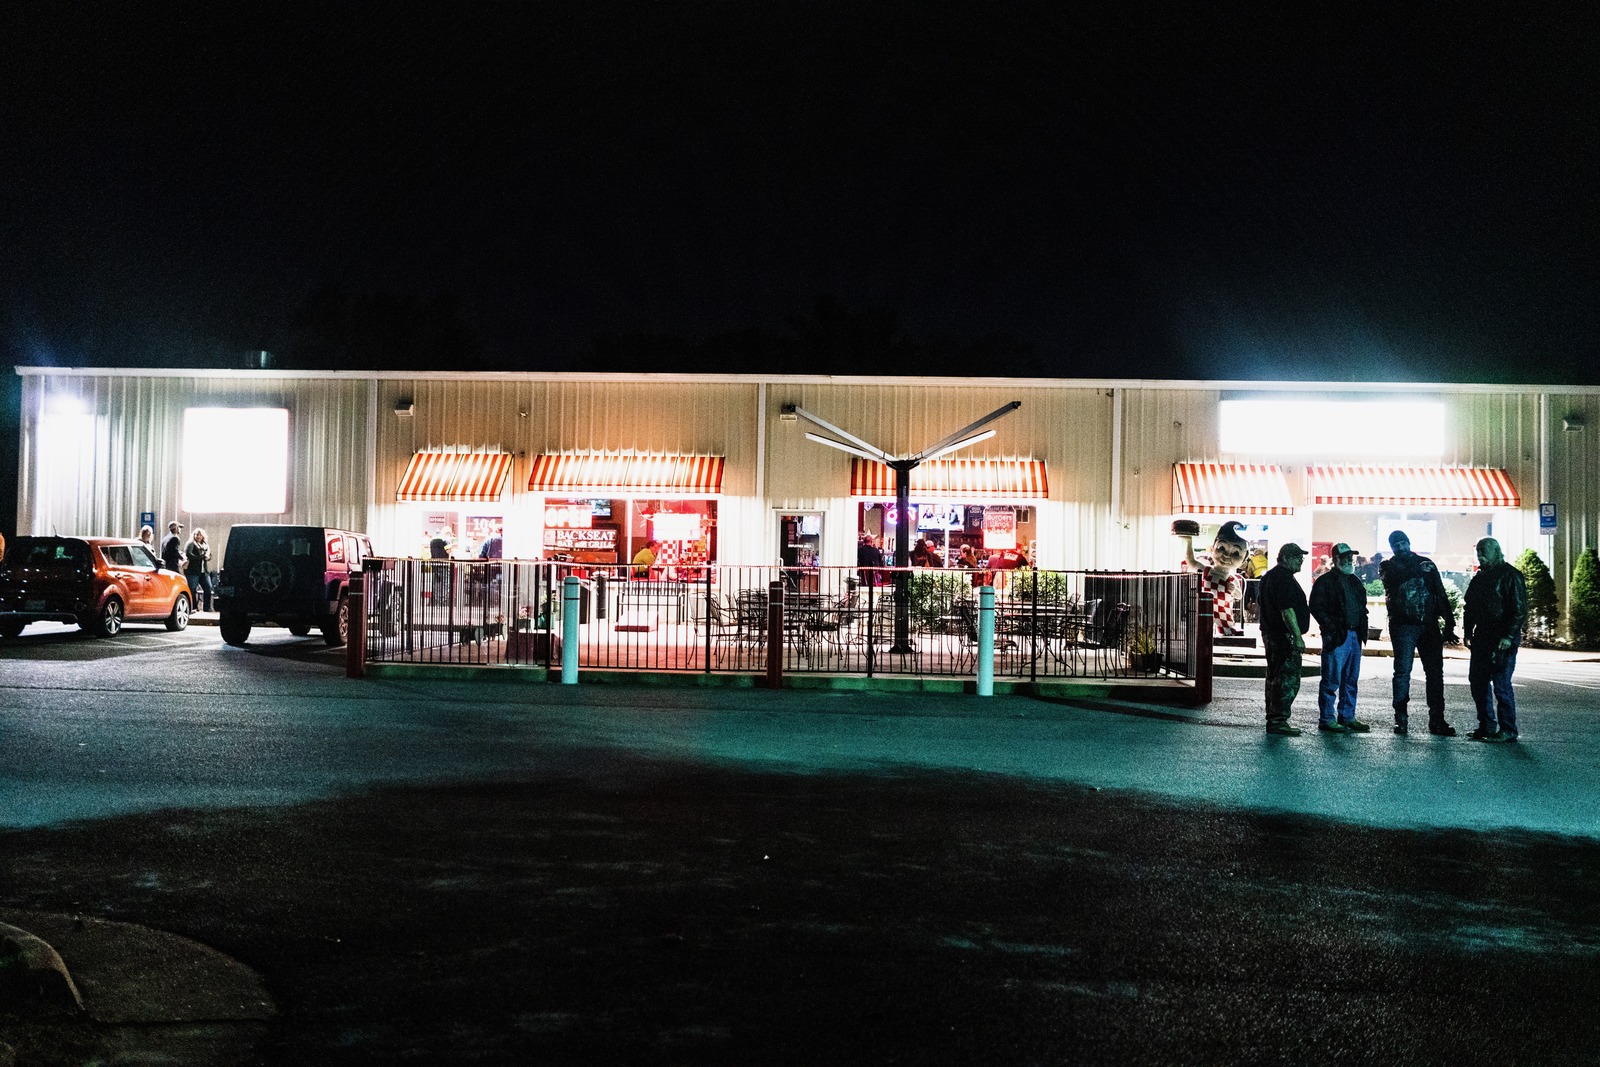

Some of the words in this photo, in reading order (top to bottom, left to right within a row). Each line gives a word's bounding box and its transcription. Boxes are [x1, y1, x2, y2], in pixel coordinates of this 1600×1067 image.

[545, 508, 592, 527] OPEN
[987, 514, 1012, 522] Burgers
[557, 530, 616, 541] BACKSEAT
[557, 540, 574, 548] BAR
